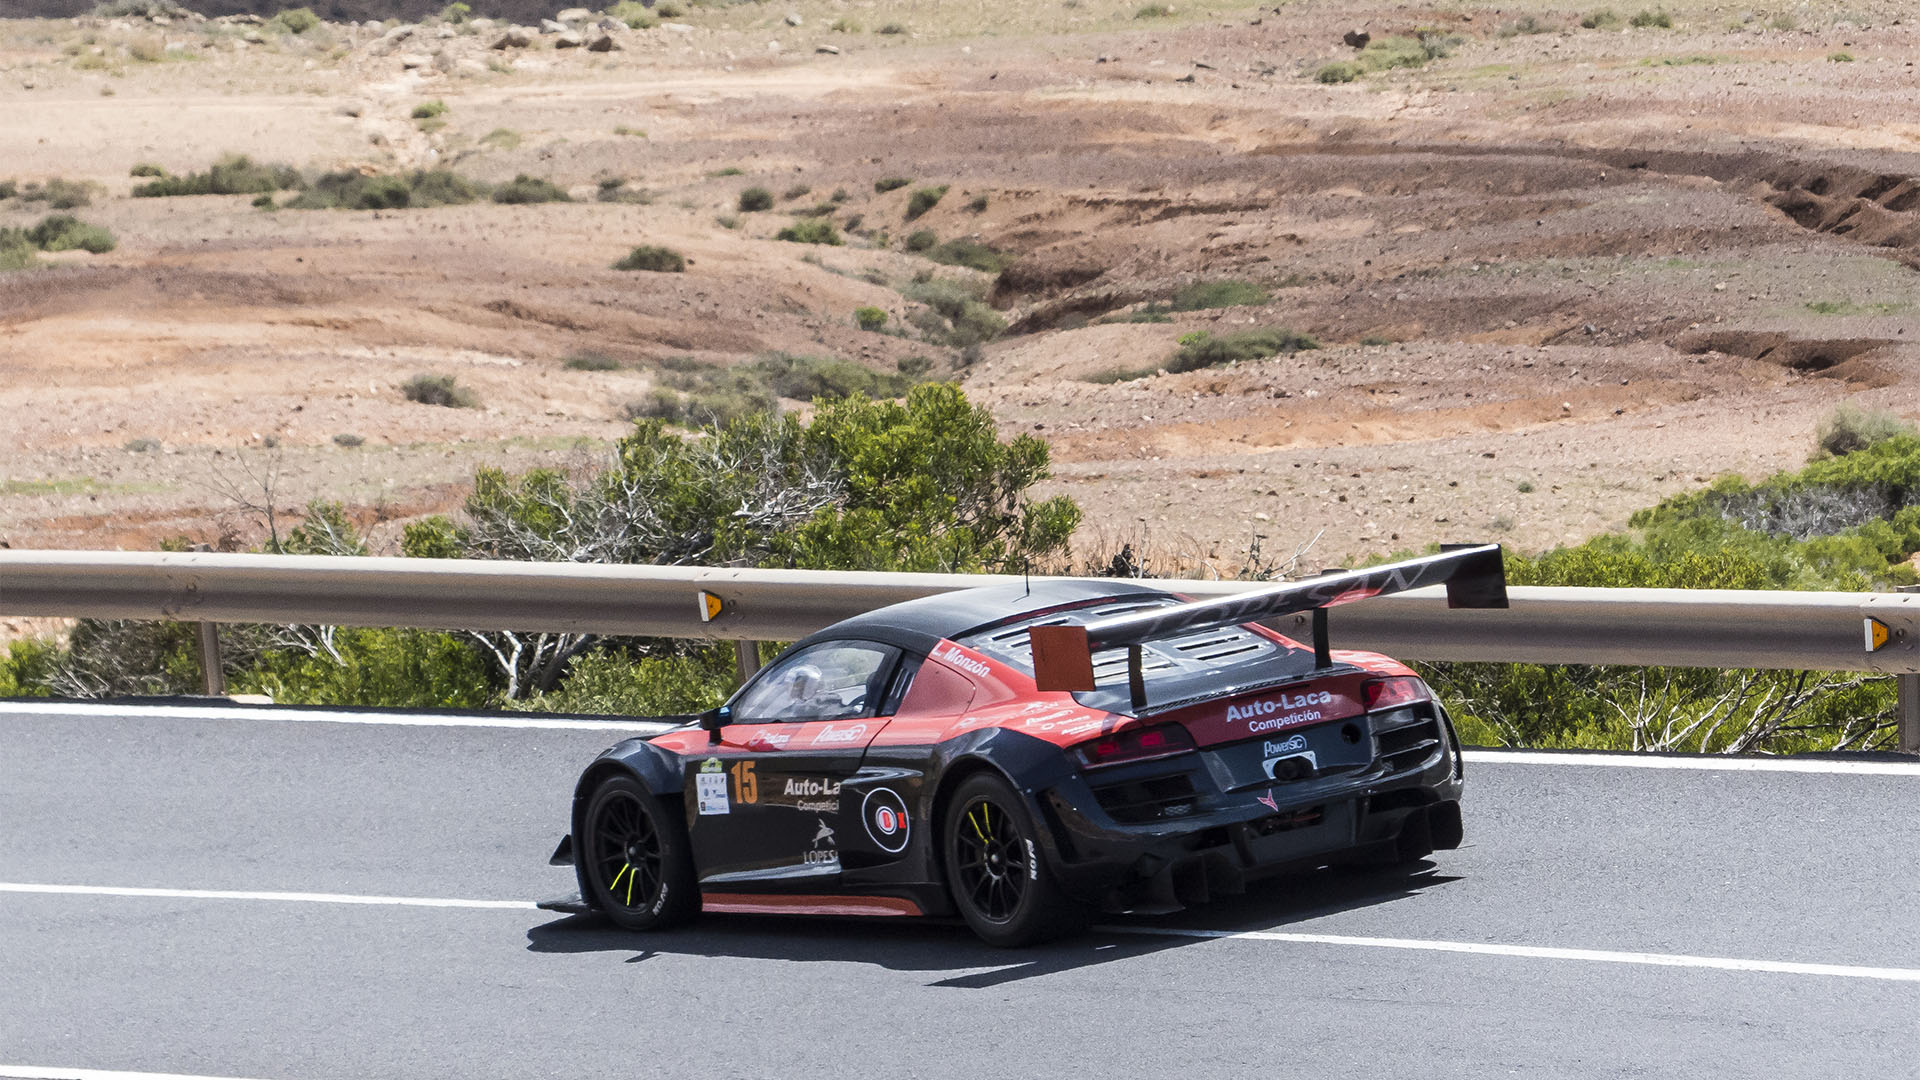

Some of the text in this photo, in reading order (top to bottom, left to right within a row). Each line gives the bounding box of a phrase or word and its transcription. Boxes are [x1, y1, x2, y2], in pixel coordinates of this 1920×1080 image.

[943, 646, 991, 678] Monzón
[1226, 690, 1332, 723] Auto-Laca
[1248, 709, 1321, 733] Competición
[731, 760, 758, 805] 15
